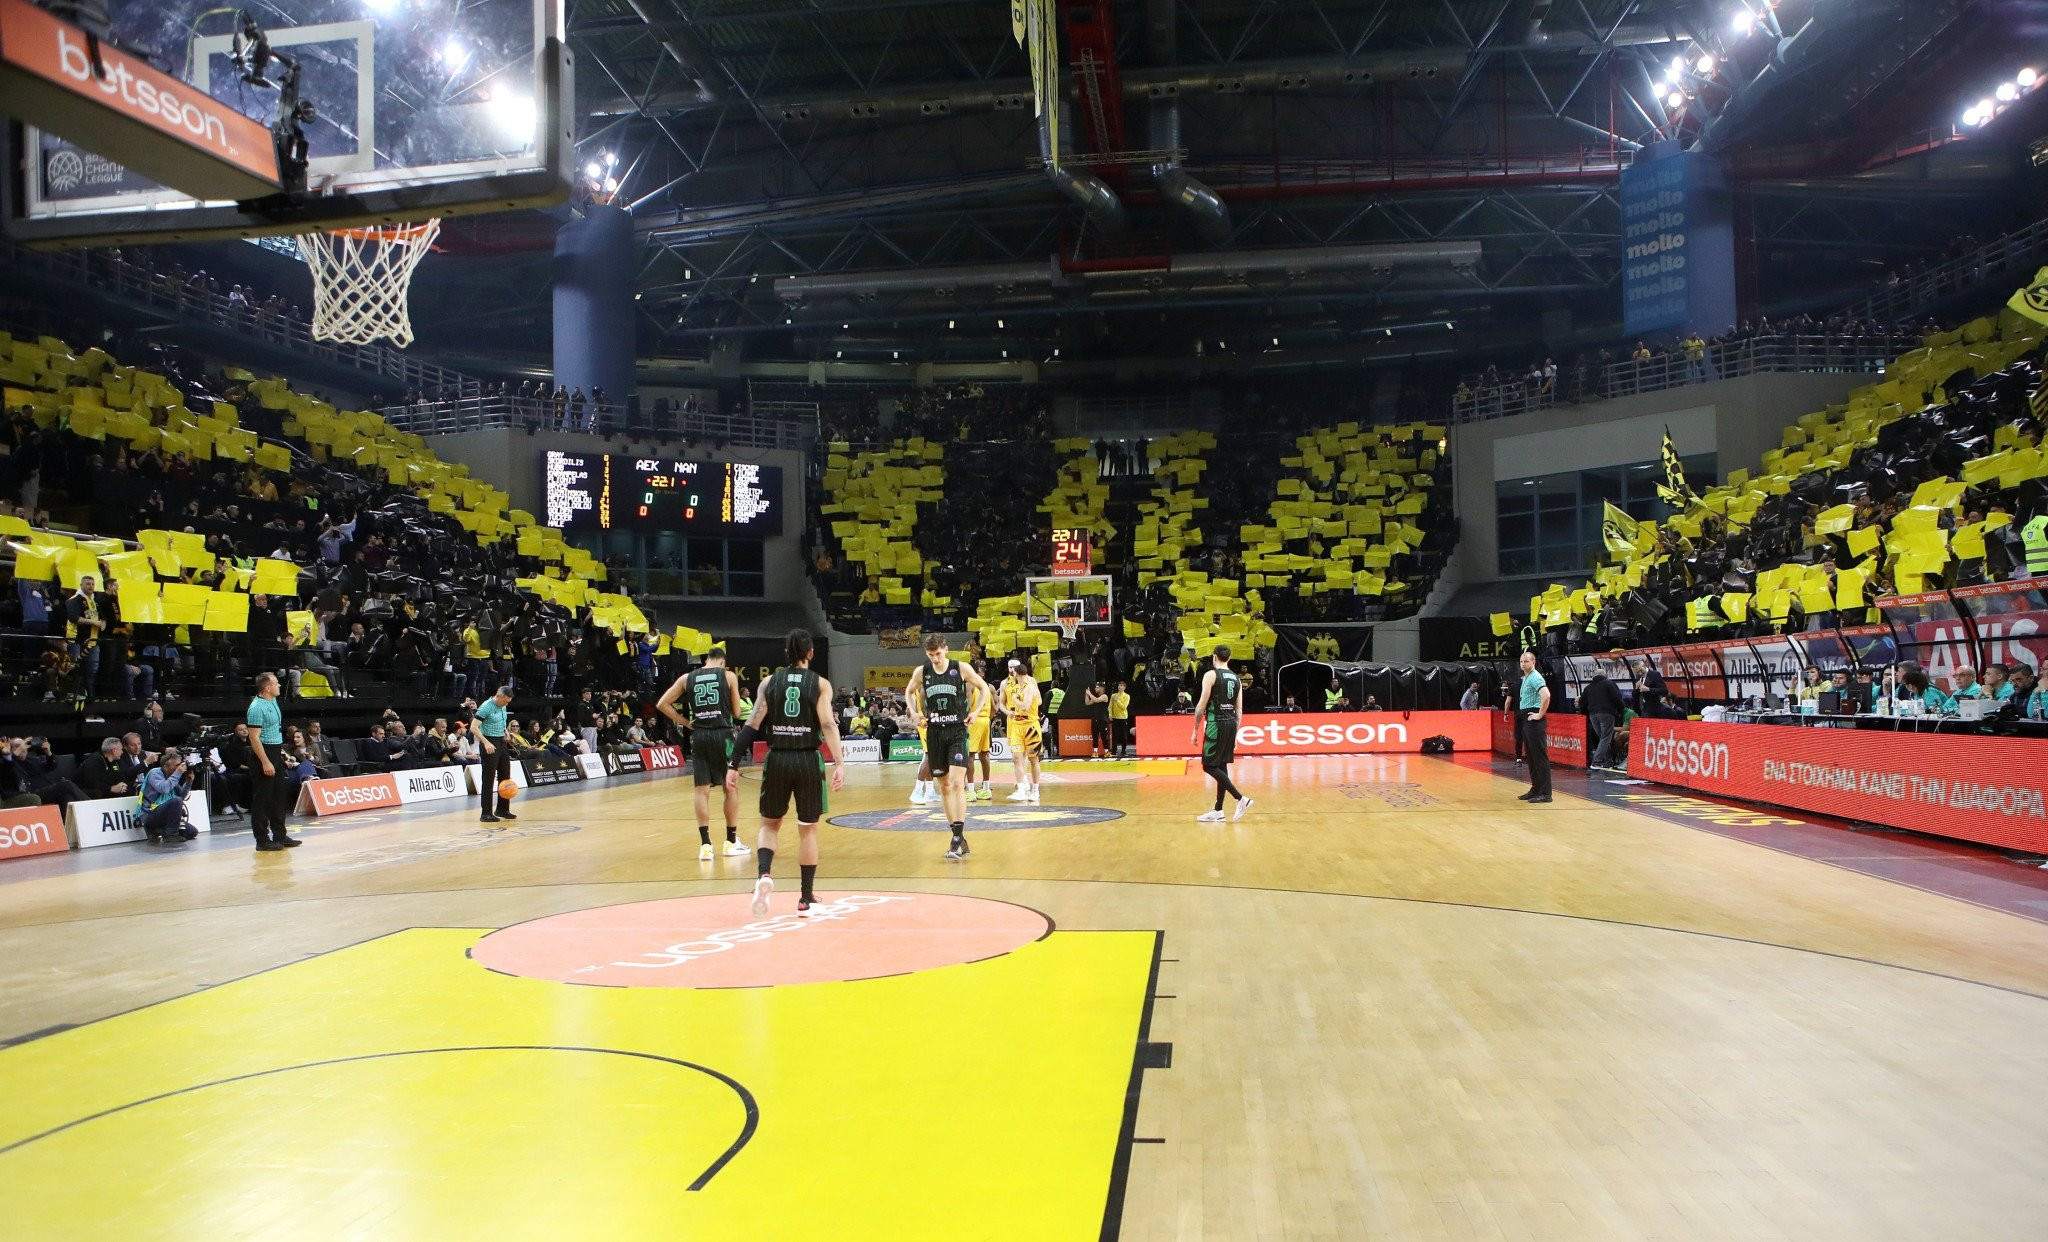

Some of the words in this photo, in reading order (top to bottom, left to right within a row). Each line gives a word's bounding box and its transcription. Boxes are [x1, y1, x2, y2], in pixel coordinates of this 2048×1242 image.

[56, 28, 228, 148] betsson
[1626, 190, 1684, 217] molto
[1626, 212, 1685, 238] molto
[1626, 233, 1685, 259] molto
[1628, 255, 1686, 280] molto
[1628, 276, 1686, 301] molto
[636, 460, 660, 472] AEK
[674, 462, 698, 474] NAN
[645, 492, 654, 504] 0
[690, 494, 698, 506] 0
[640, 506, 648, 516] 0
[686, 508, 694, 519] 0
[1056, 542, 1082, 560] 24
[1929, 618, 2040, 686] AVIS
[1730, 658, 1777, 683] Allianz
[694, 682, 720, 706] 25
[784, 686, 800, 718] 8
[1227, 680, 1236, 700] 6
[936, 698, 948, 710] 17
[1236, 721, 1407, 747] etsson
[1554, 735, 1582, 752] ΔΙΑΦΟΡΑ
[650, 746, 679, 768] AVIS
[1644, 728, 1729, 780] betsson
[325, 781, 392, 808] betsson
[408, 776, 442, 794] Allianz
[1764, 760, 1786, 782] ΕΝΑ
[1788, 762, 1857, 792] ΣΤΟΙΧΗΜΑ
[1860, 770, 1905, 798] ΚΑΝΕΙ
[1909, 775, 1946, 804] ΤΗΝ
[1949, 781, 2046, 820] ΔΙΑΦΟΡΑ
[0, 822, 51, 848] son
[610, 894, 915, 970] betsson
